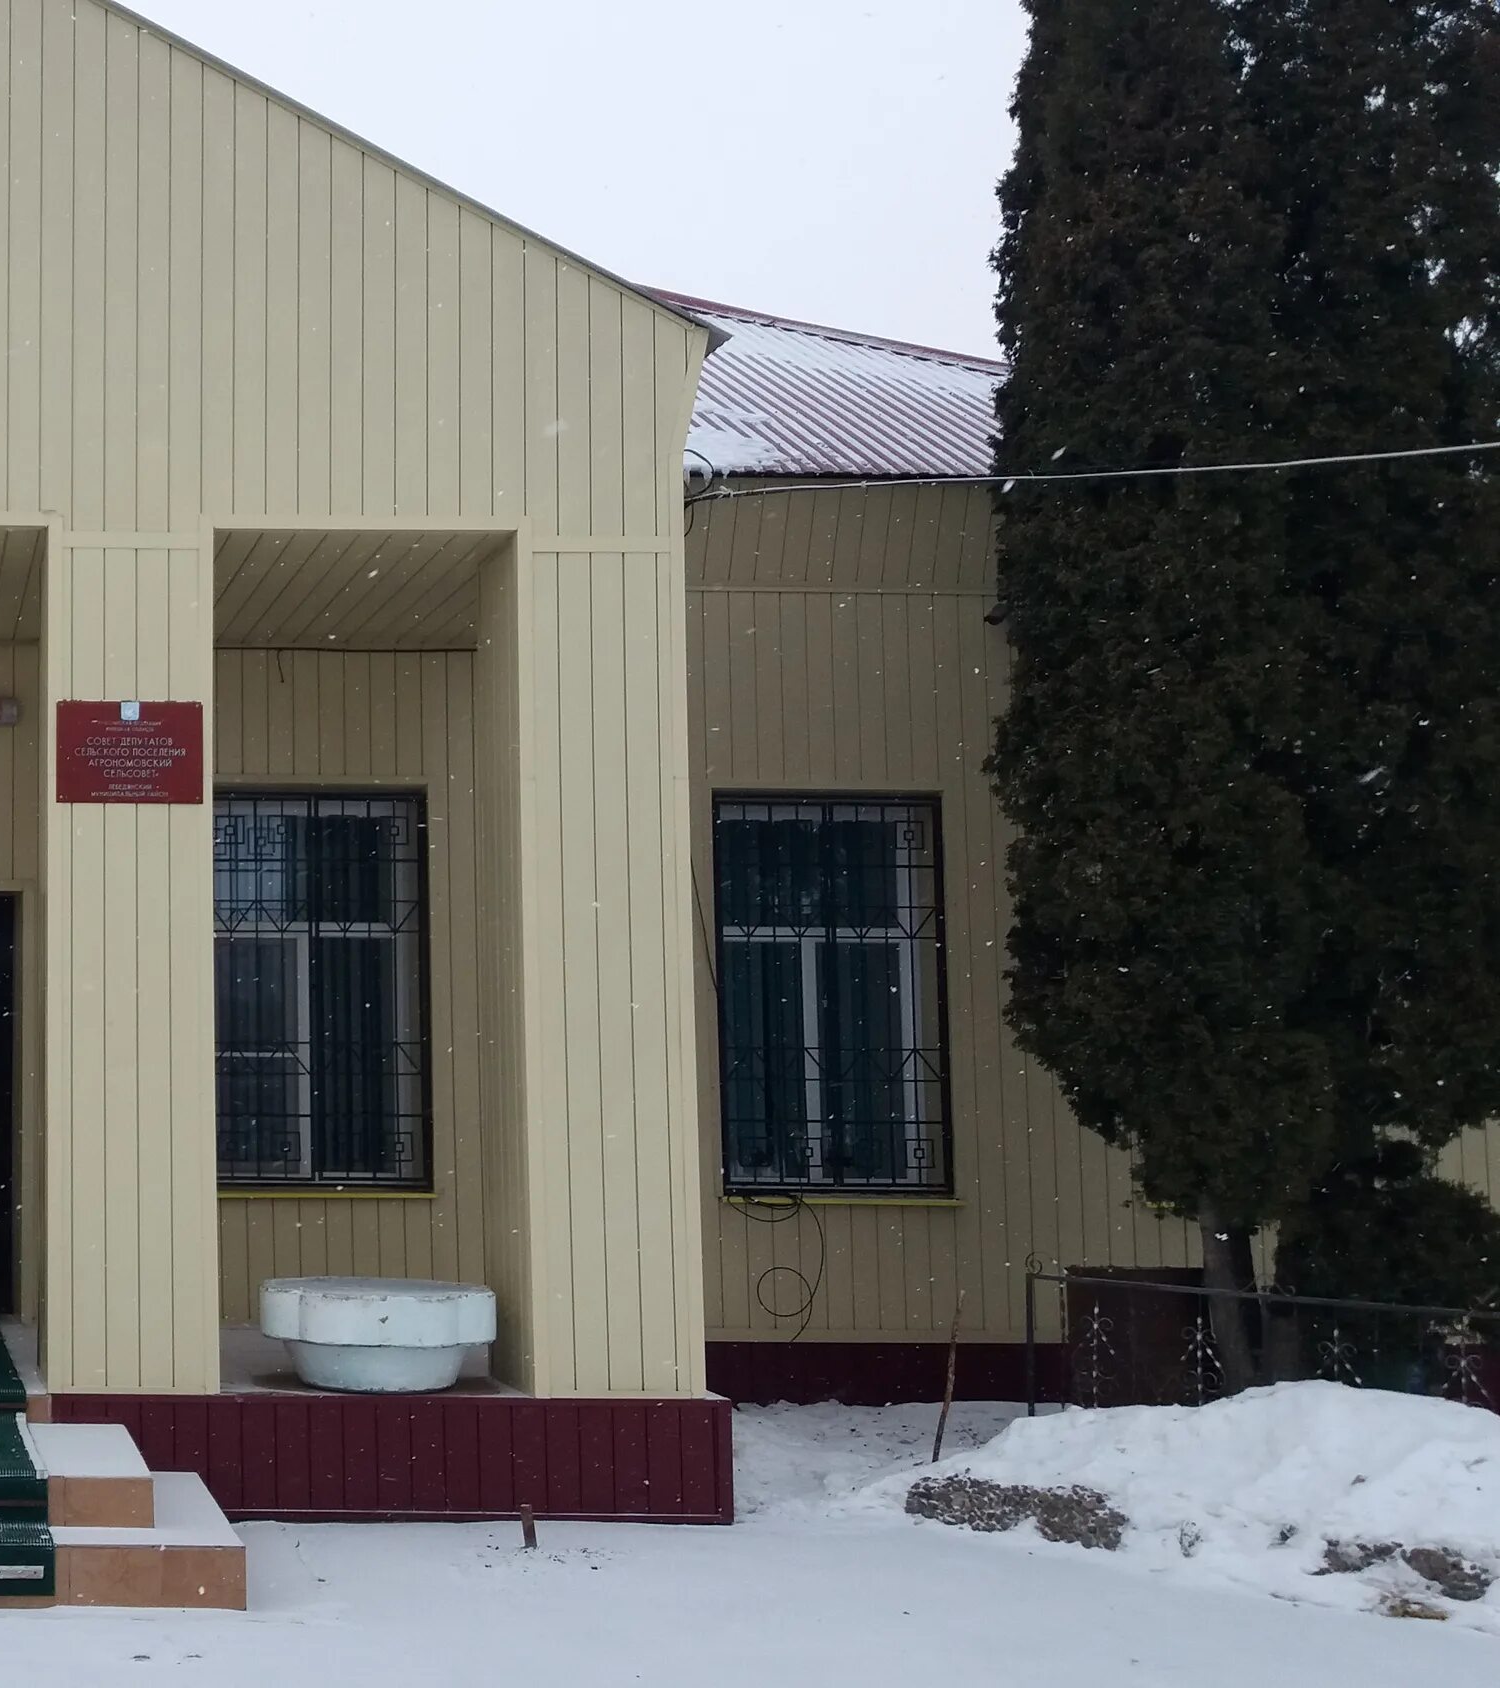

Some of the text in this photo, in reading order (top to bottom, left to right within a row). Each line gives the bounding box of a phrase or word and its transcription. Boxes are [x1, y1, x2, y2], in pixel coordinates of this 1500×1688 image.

[86, 737, 173, 747] СОВЕТ ДЕПУТАТОВ
[74, 747, 186, 757] СЕЛЬСКОГО ПОСЕЛЕНИЯ
[88, 758, 173, 767] АГРОНОМОВСКИЙ
[103, 769, 156, 778] СЕЛЬСОВЕТ
